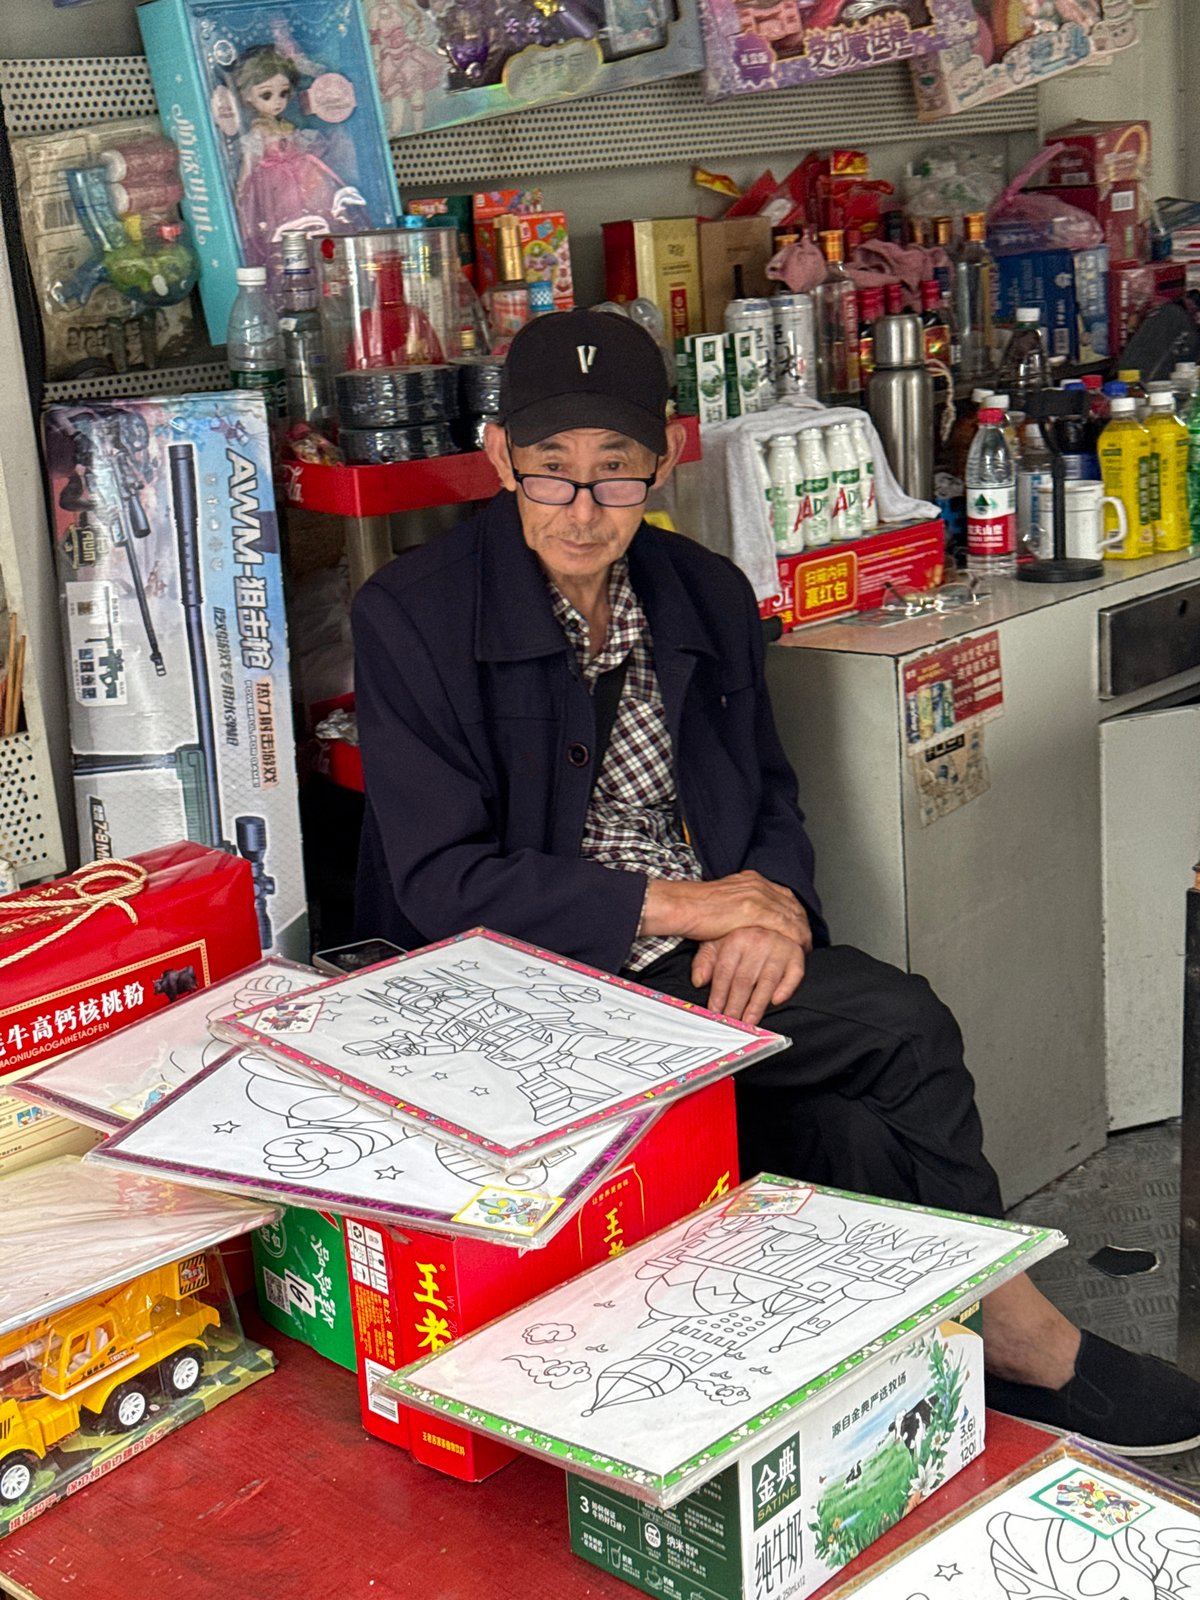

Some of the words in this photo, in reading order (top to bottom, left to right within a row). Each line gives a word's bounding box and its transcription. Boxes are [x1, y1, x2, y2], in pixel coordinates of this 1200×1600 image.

[576, 344, 597, 374] V
[226, 447, 274, 670] AWM-狙击枪
[256, 681, 278, 784] 热力射击游戏
[831, 1370, 907, 1440] 源自金典严选牧场
[579, 1495, 590, 1514] 3
[756, 1445, 797, 1509] 金典
[757, 1483, 797, 1522] SATINE
[755, 1508, 803, 1600] 纯牛奶
